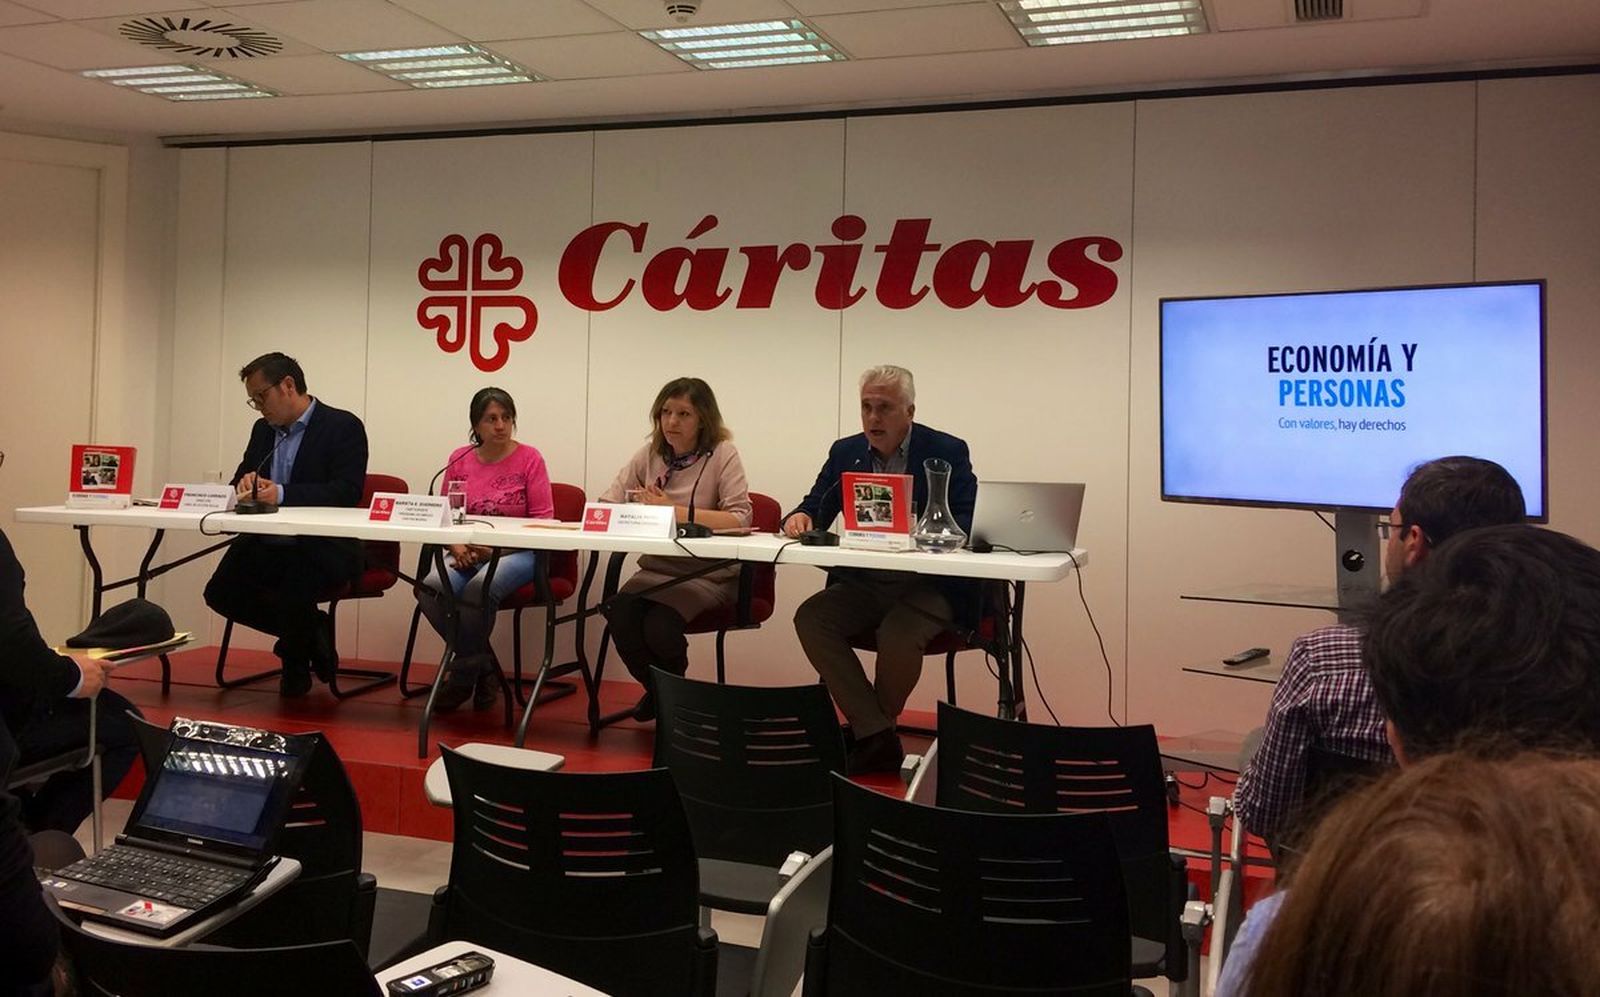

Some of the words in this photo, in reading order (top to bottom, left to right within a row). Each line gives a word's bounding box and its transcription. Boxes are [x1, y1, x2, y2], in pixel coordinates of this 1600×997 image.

[558, 214, 1123, 312] Cáritas
[1268, 337, 1392, 373] ECONOMÍA
[1401, 343, 1418, 372] Y
[1279, 379, 1406, 407] PERSONAS
[1278, 417, 1297, 429] Con
[1300, 418, 1337, 431] valores,
[1338, 419, 1356, 432] hay
[1359, 418, 1406, 431] derechos
